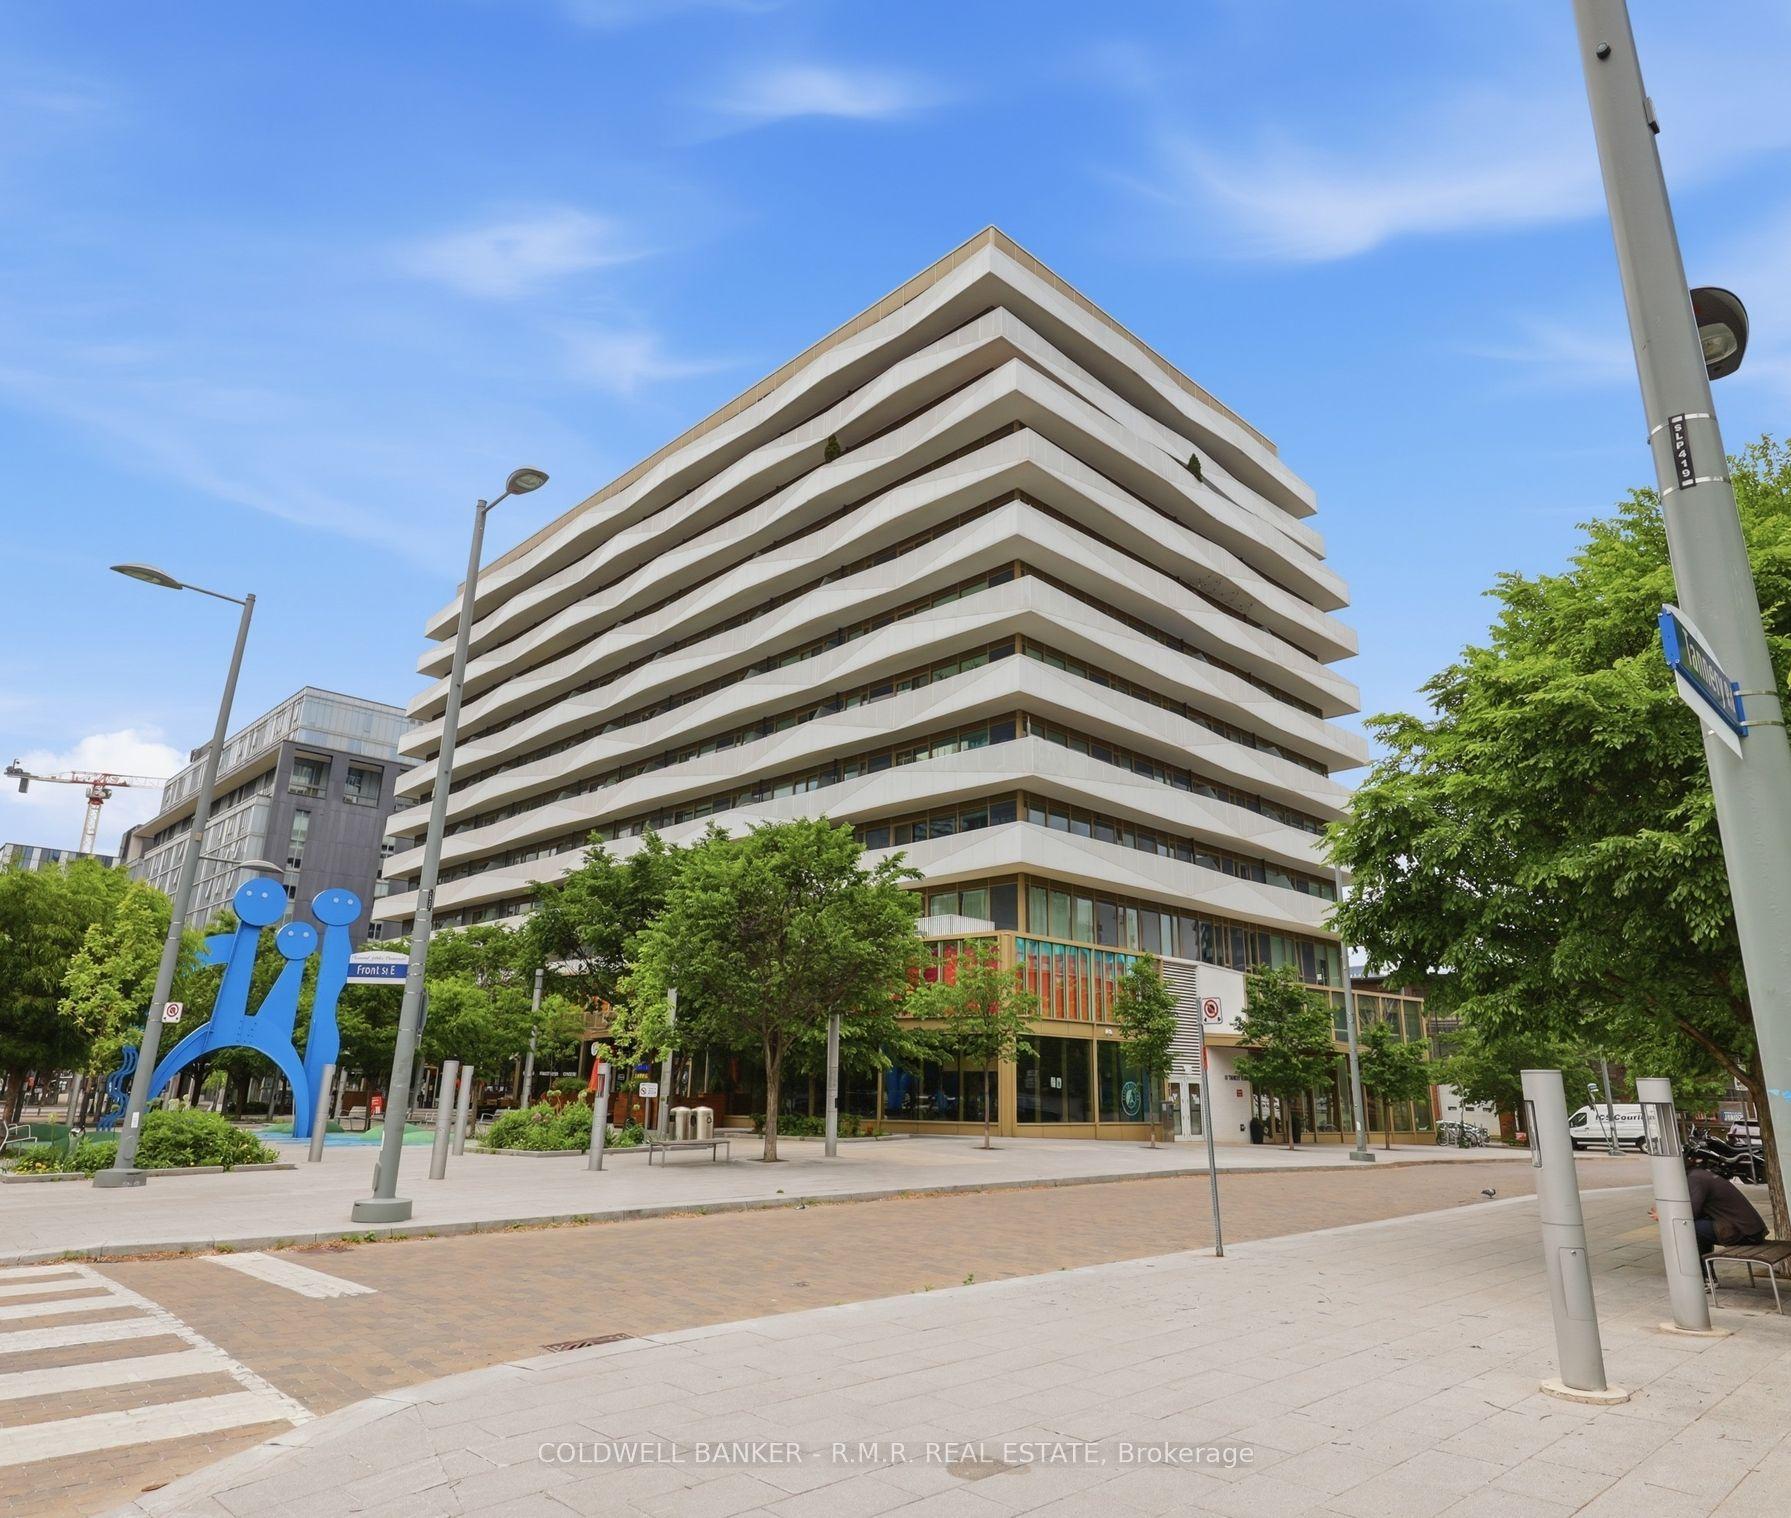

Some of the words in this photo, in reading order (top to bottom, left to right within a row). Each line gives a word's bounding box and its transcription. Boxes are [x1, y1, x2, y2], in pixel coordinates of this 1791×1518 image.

[1674, 423, 1691, 478] SLP419
[357, 965, 380, 975] Front
[390, 965, 396, 975] E
[1614, 1113, 1654, 1121] Couri
